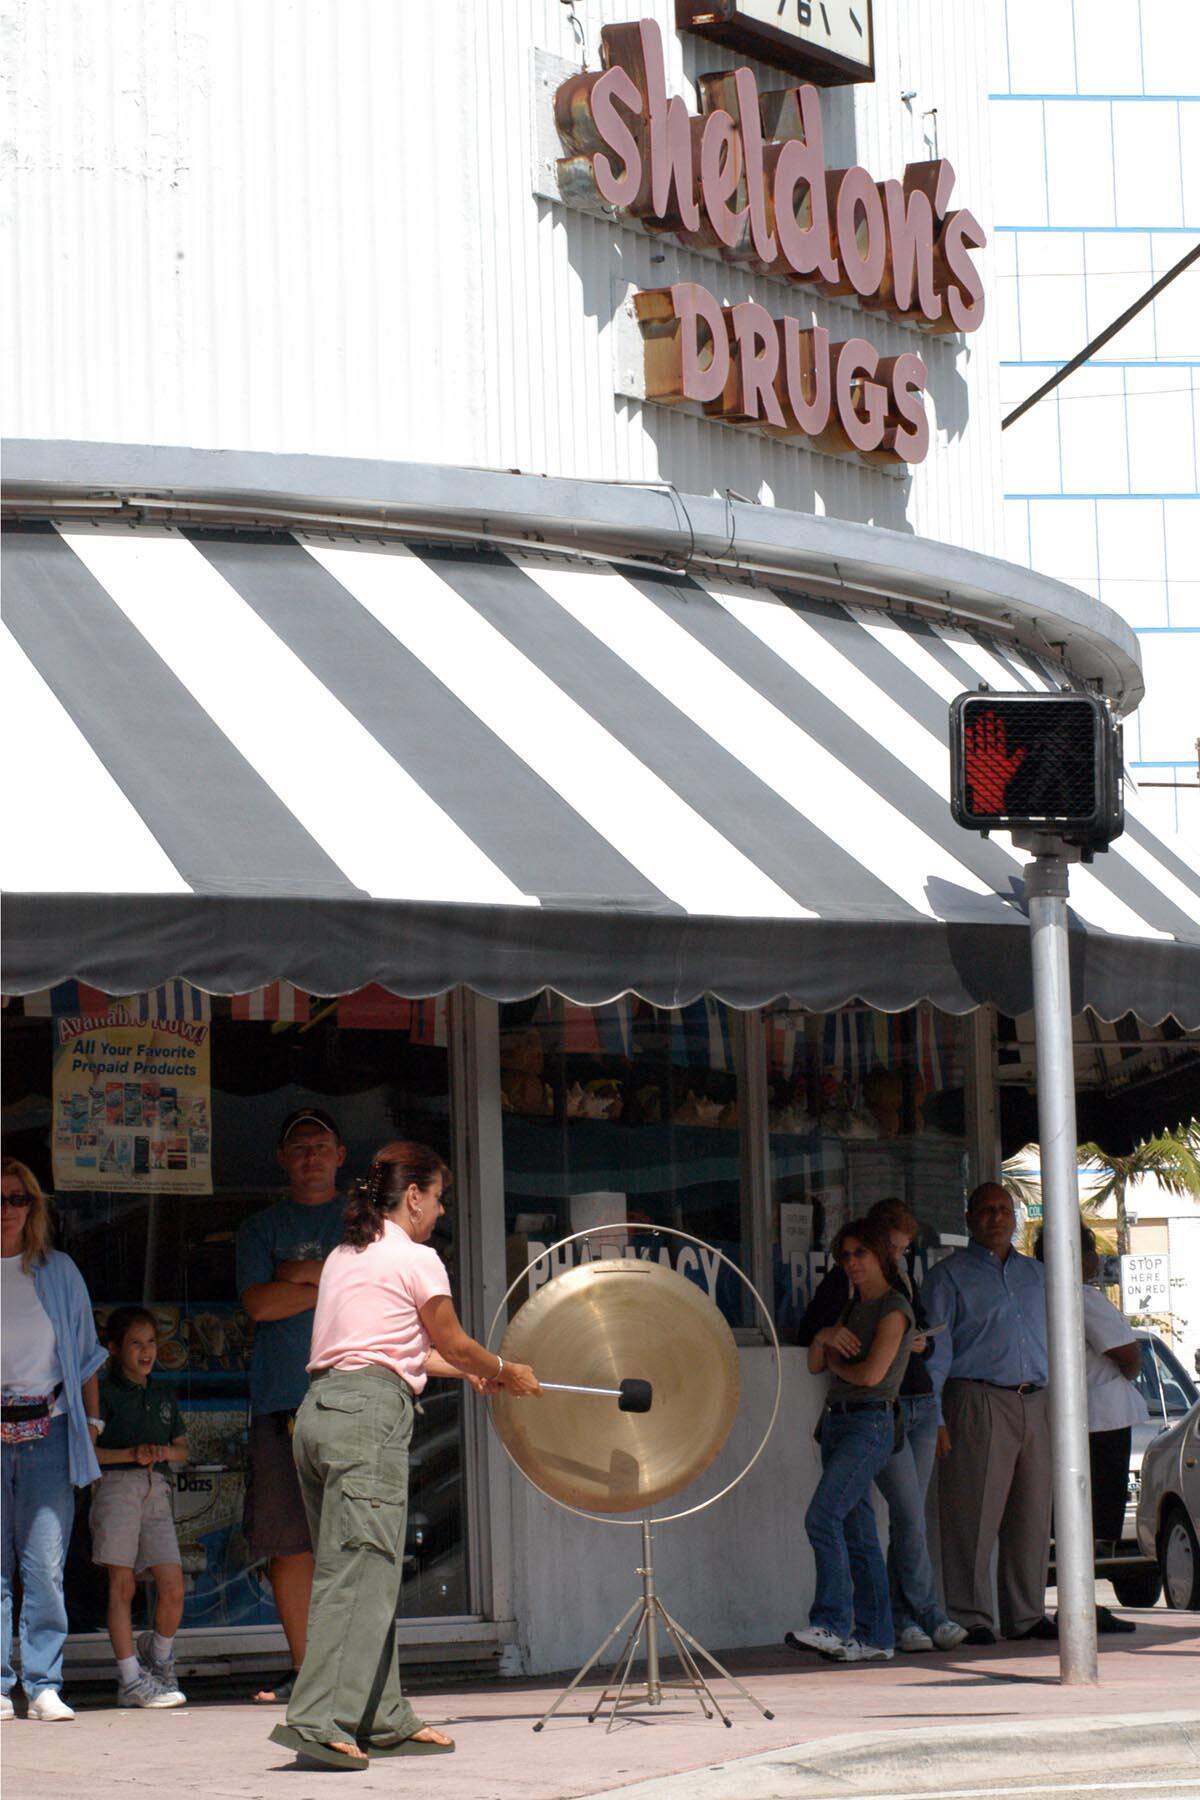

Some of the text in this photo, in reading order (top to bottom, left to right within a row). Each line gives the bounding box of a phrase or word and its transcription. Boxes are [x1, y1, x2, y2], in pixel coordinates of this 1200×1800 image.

[590, 18, 987, 333] Sheldon's
[672, 282, 930, 465] DRUGS
[73, 1040, 196, 1059] All Your Favorite
[72, 1059, 197, 1077] Prepaid Products
[1028, 1206, 1043, 1217] COL
[1129, 1258, 1162, 1271] STOP
[1131, 1273, 1160, 1282] HERE
[1127, 1283, 1166, 1295] ON RED
